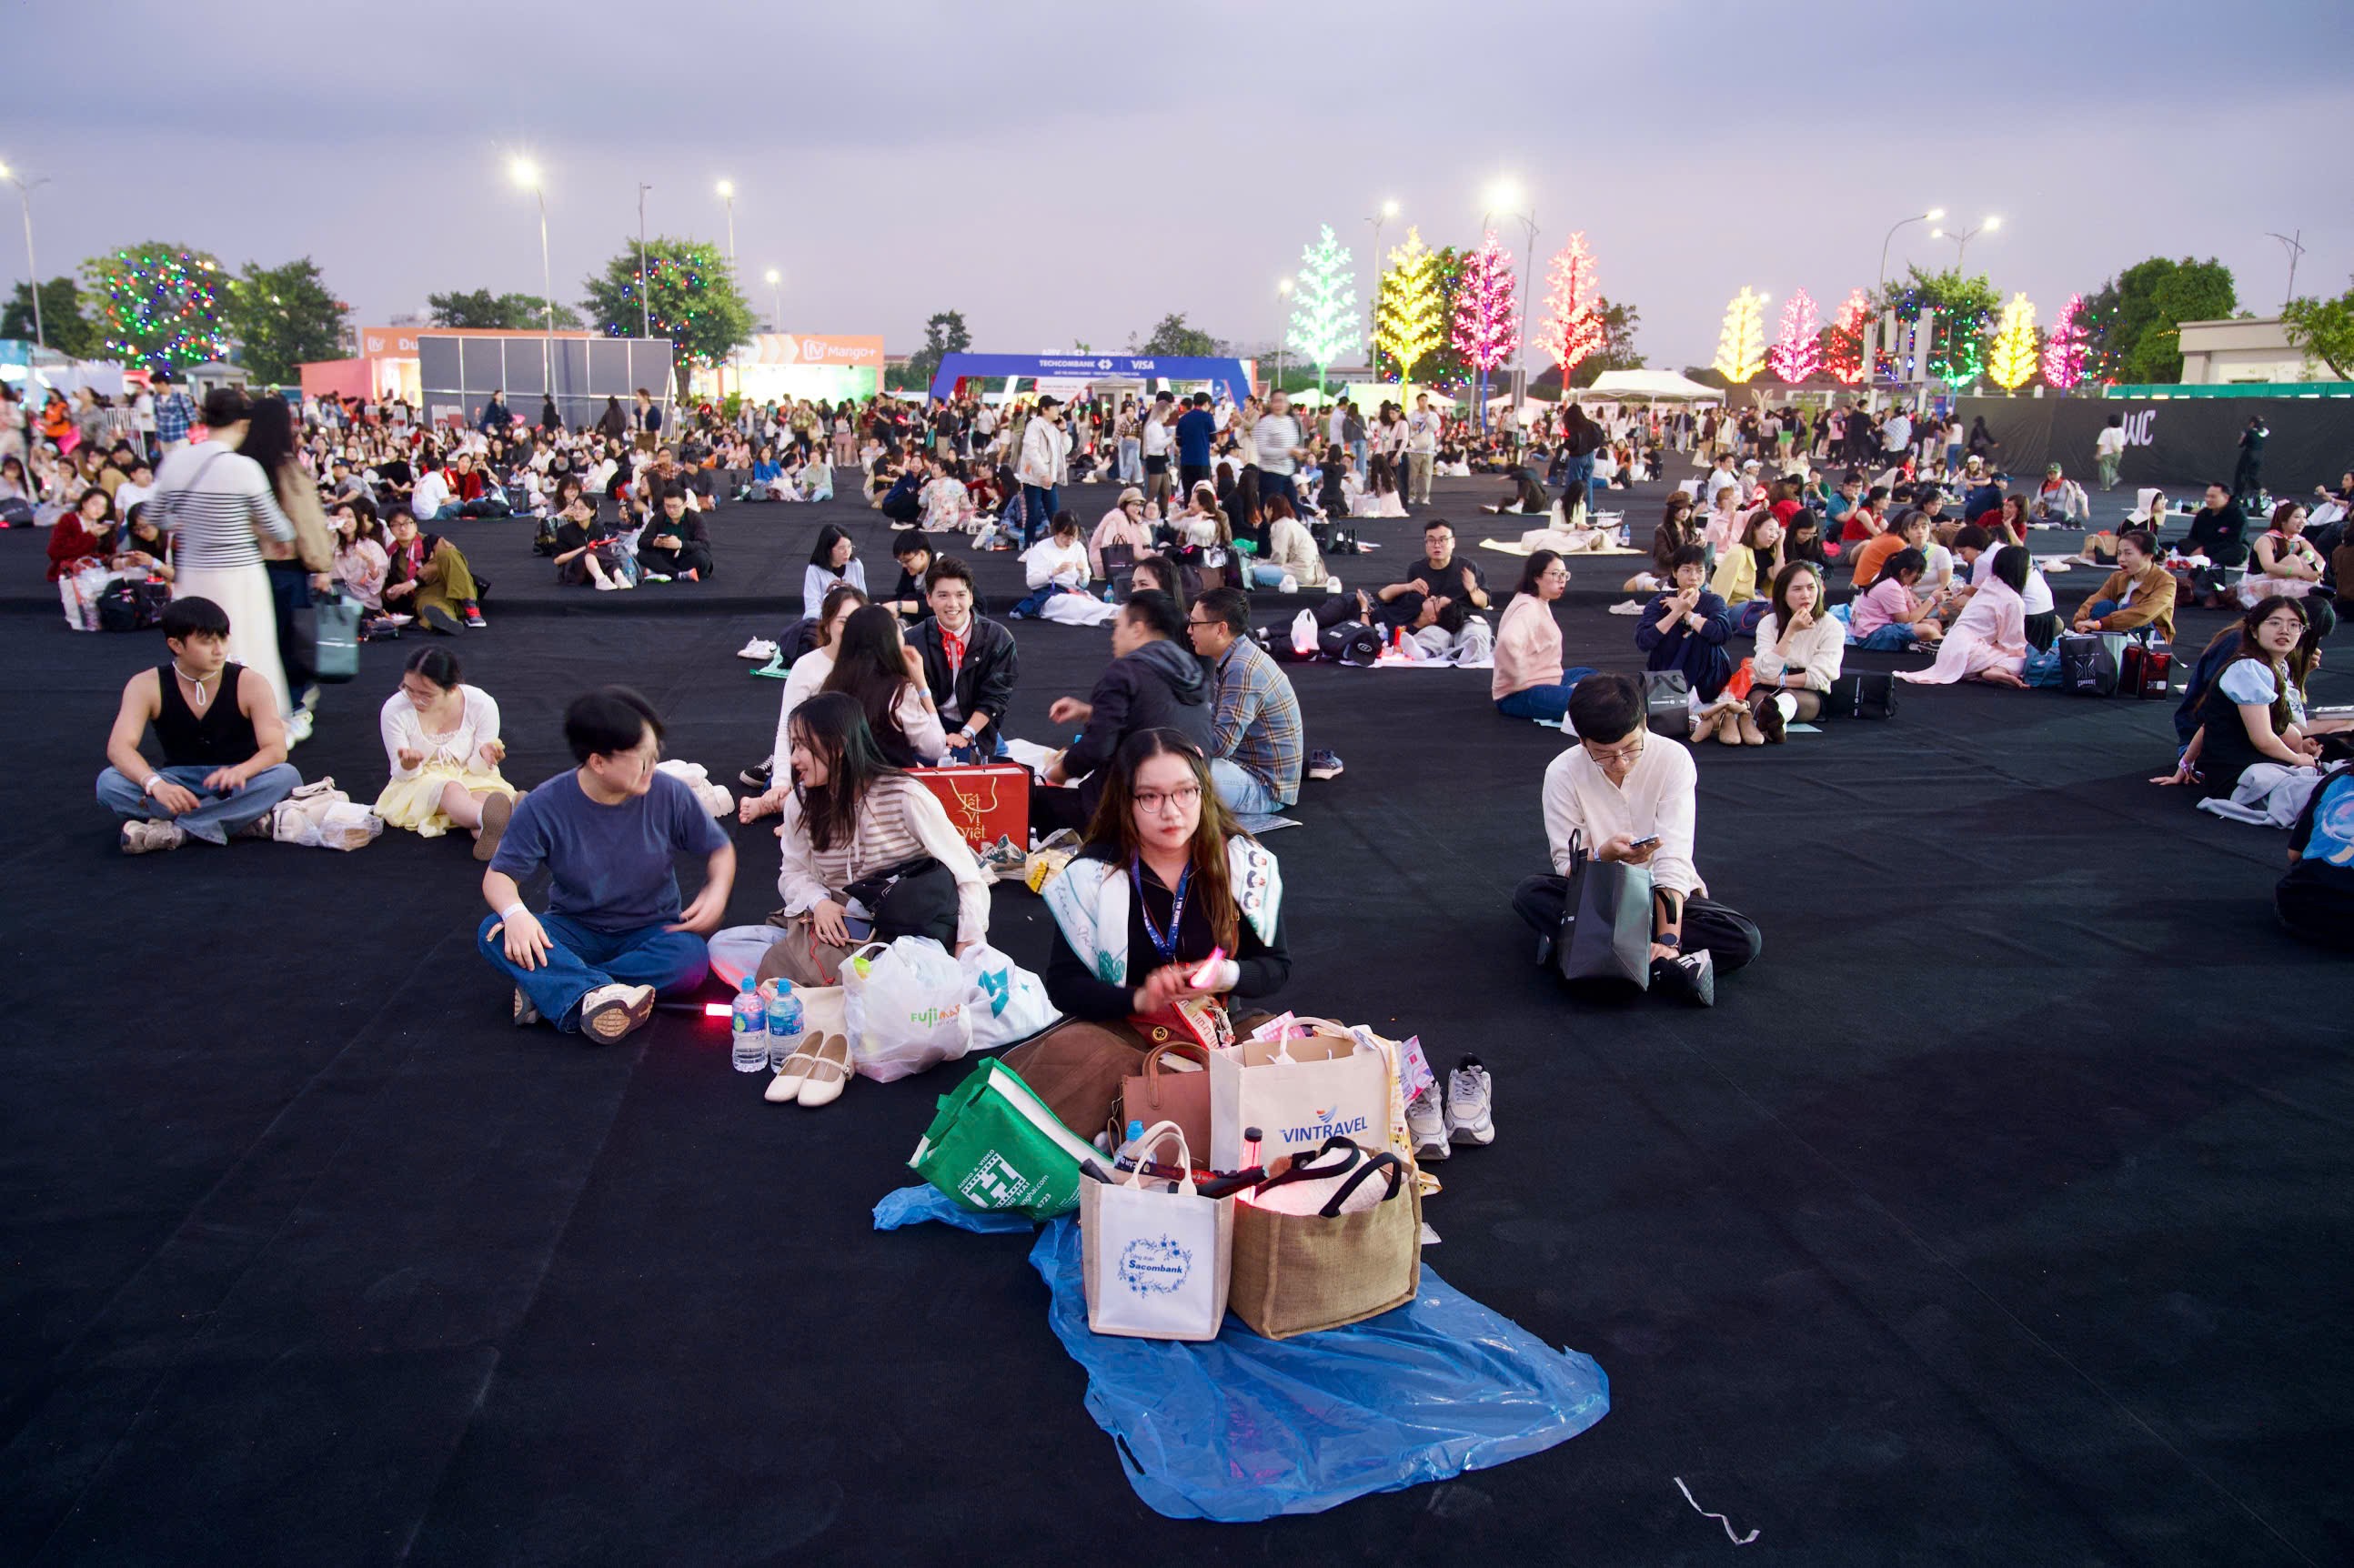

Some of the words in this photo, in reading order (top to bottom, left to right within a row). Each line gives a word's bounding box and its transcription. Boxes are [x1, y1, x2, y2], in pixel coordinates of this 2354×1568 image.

[829, 346, 876, 359] Mango+
[1039, 359, 1095, 368] TECHCOMBANK
[1131, 360, 1154, 370] VISA
[2122, 409, 2156, 446] WC
[956, 824, 987, 840] Việt
[1282, 1116, 1368, 1142] VINTRAVEL
[957, 1172, 973, 1190] AUDIO
[978, 1149, 995, 1166] VIDEO
[1128, 1260, 1182, 1274] Sacombank
